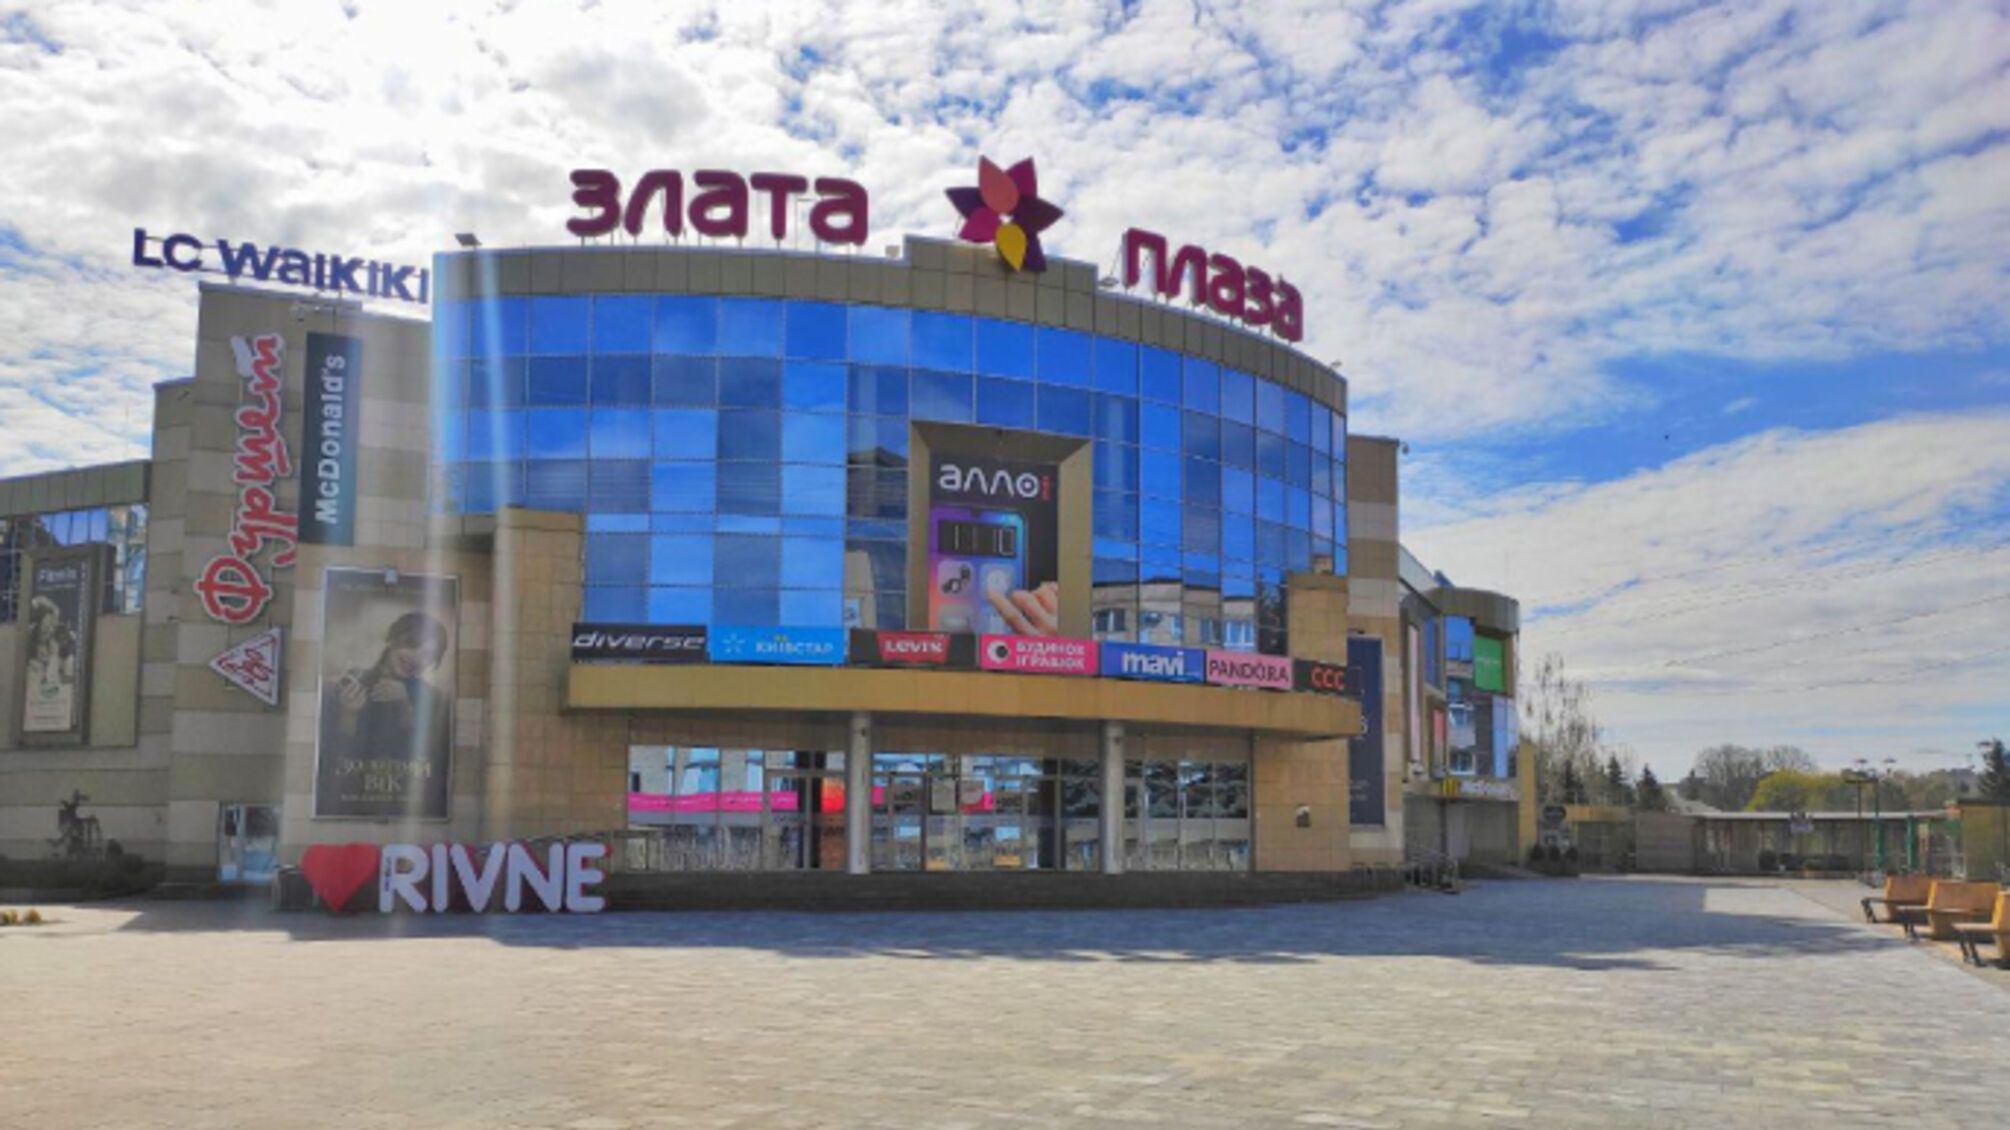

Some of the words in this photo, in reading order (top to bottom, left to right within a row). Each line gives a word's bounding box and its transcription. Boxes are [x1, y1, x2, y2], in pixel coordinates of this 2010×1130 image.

[133, 228, 202, 272] LC
[315, 353, 346, 525] McDonald's
[573, 631, 705, 650] diverse
[1016, 640, 1085, 656] БУДИНОК
[1122, 651, 1185, 676] mavi
[1208, 660, 1290, 682] PANDORA
[1311, 667, 1345, 690] CCC
[379, 842, 607, 913] RIVNE
